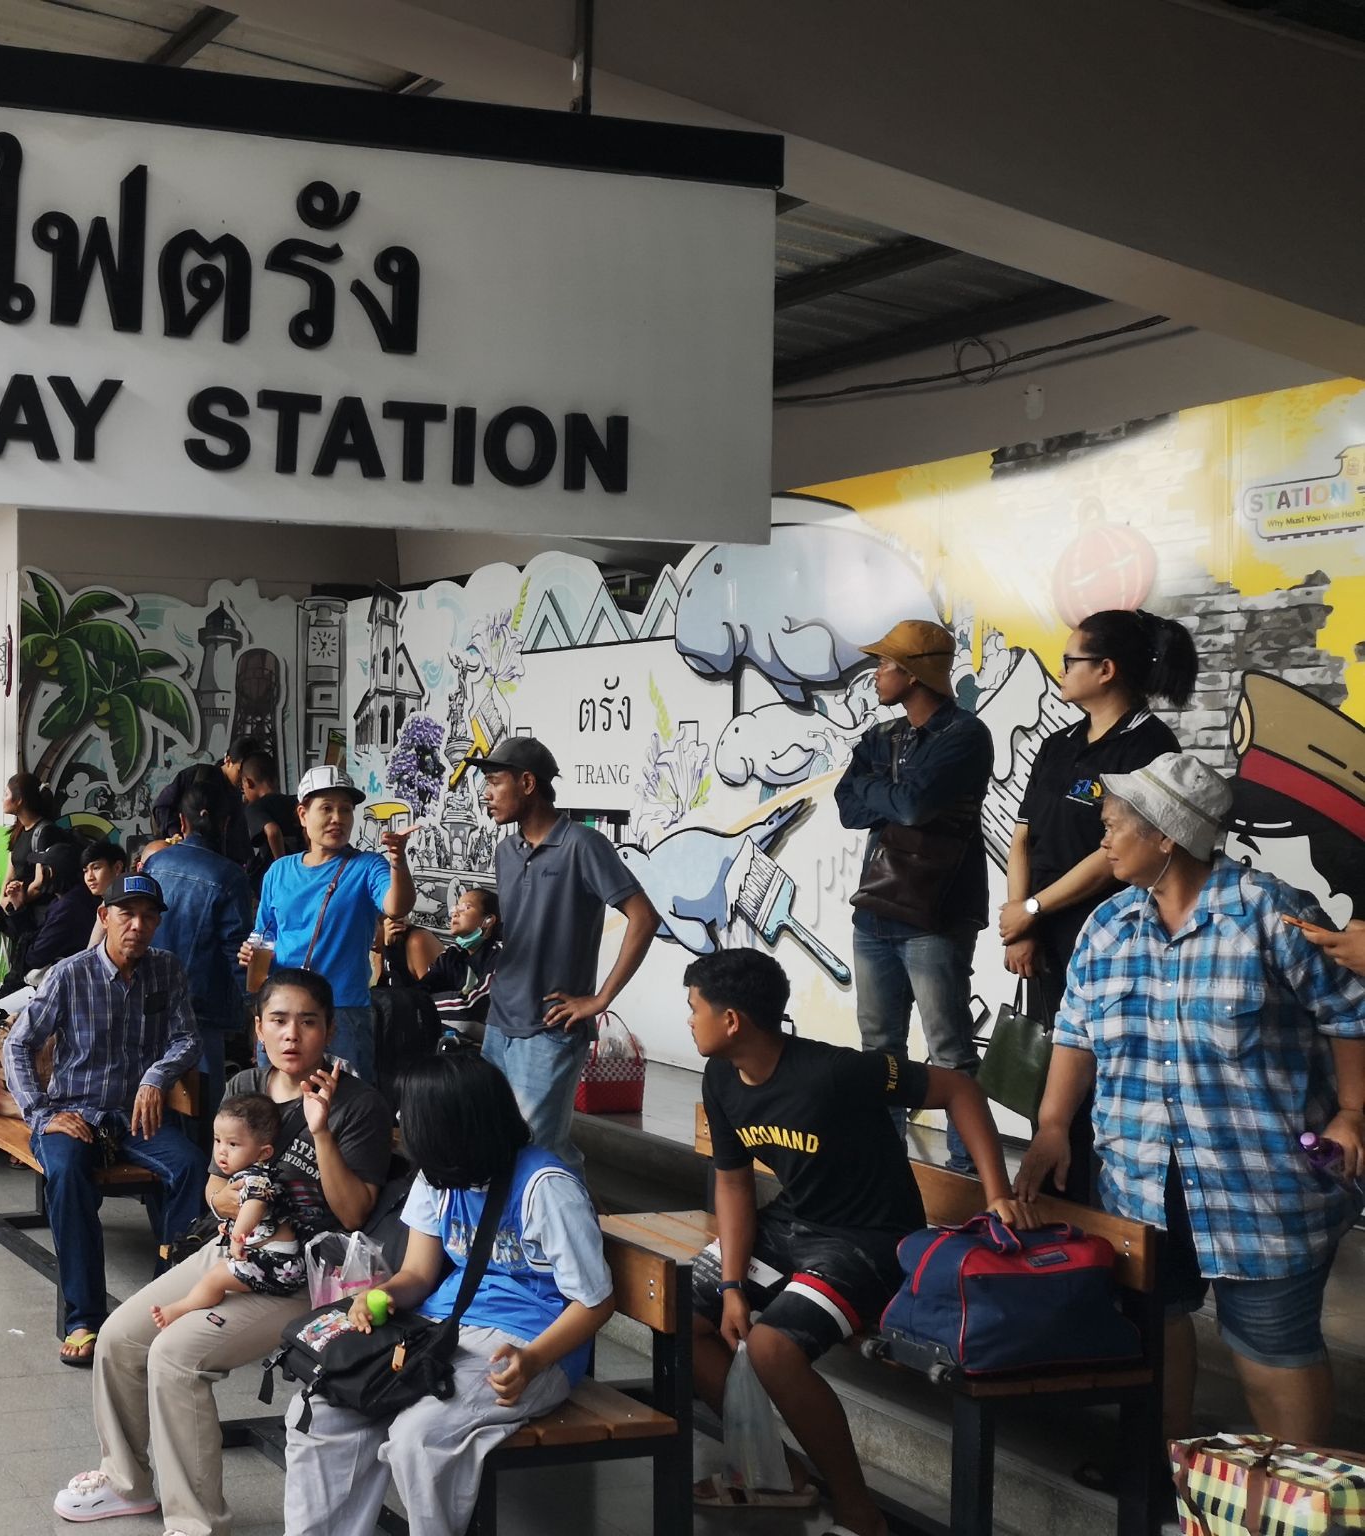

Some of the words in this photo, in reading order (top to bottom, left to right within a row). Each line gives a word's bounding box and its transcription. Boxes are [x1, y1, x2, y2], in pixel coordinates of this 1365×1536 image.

[184, 386, 631, 496] STATION
[1250, 482, 1347, 513] STATION
[1267, 519, 1284, 528] Why
[1285, 516, 1305, 526] Must
[1306, 514, 1322, 523] You
[578, 675, 631, 733] ตรัง
[574, 763, 631, 785] TRANG
